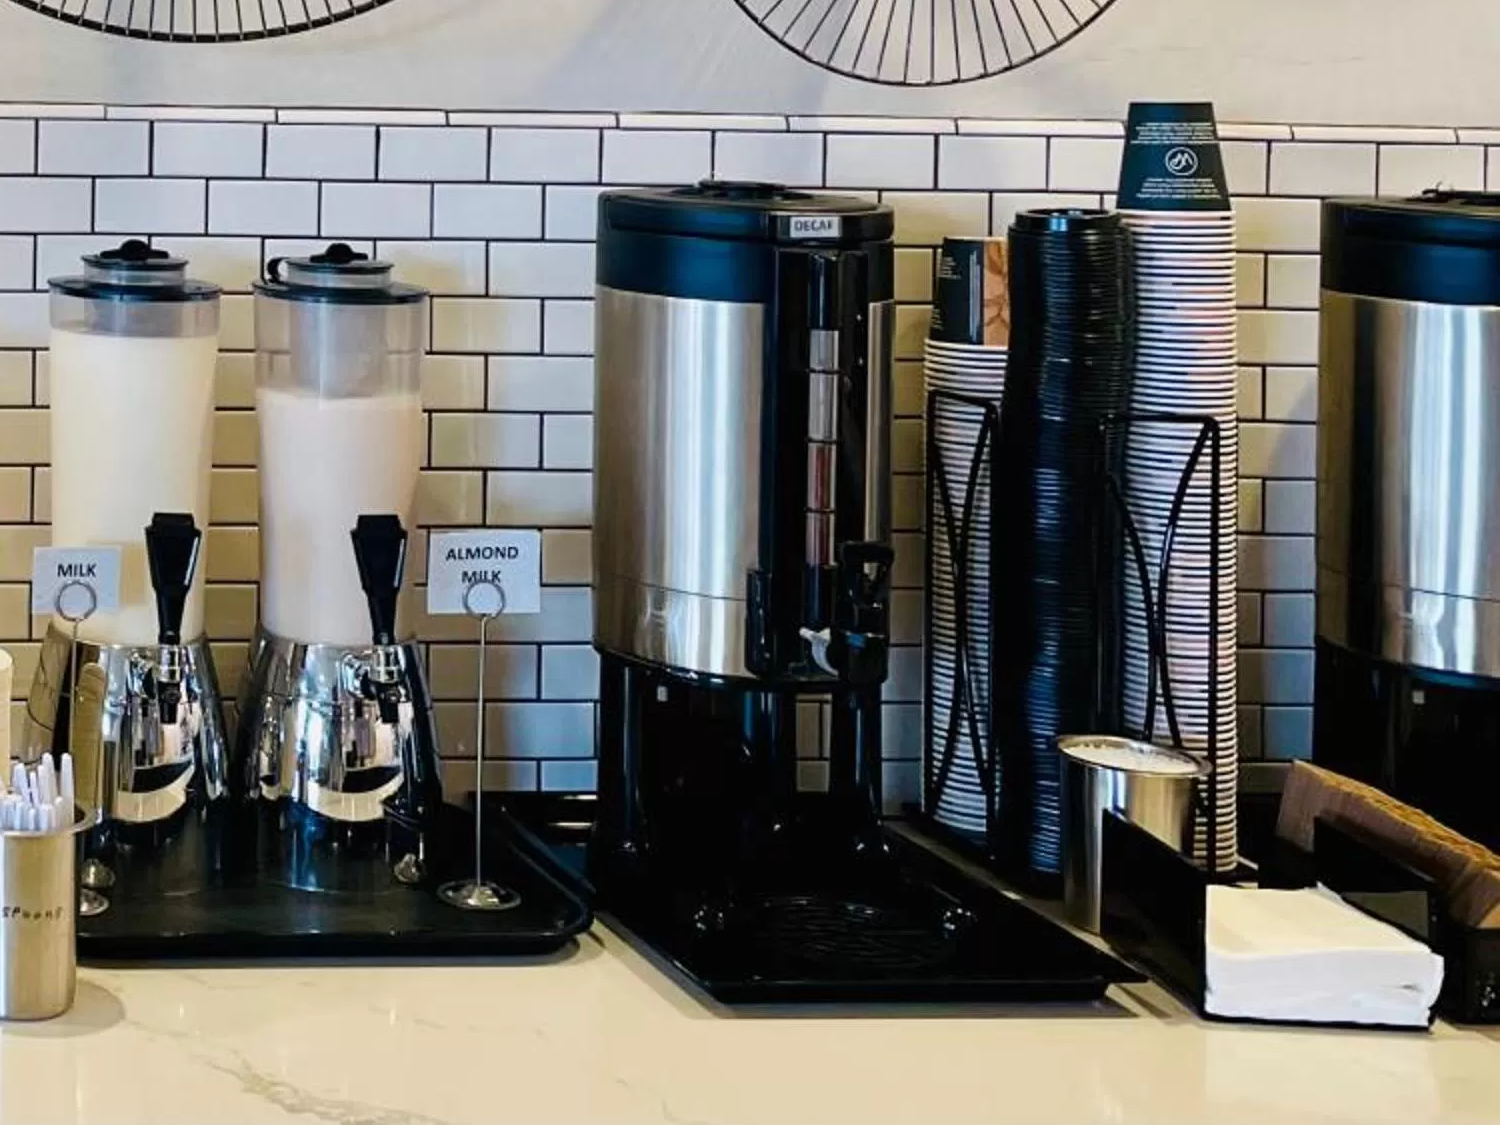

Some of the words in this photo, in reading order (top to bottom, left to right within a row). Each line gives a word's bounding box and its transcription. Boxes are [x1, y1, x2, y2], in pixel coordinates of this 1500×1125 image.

[445, 546, 519, 561] ALMOND
[57, 563, 97, 577] MILK
[461, 570, 501, 584] MILK
